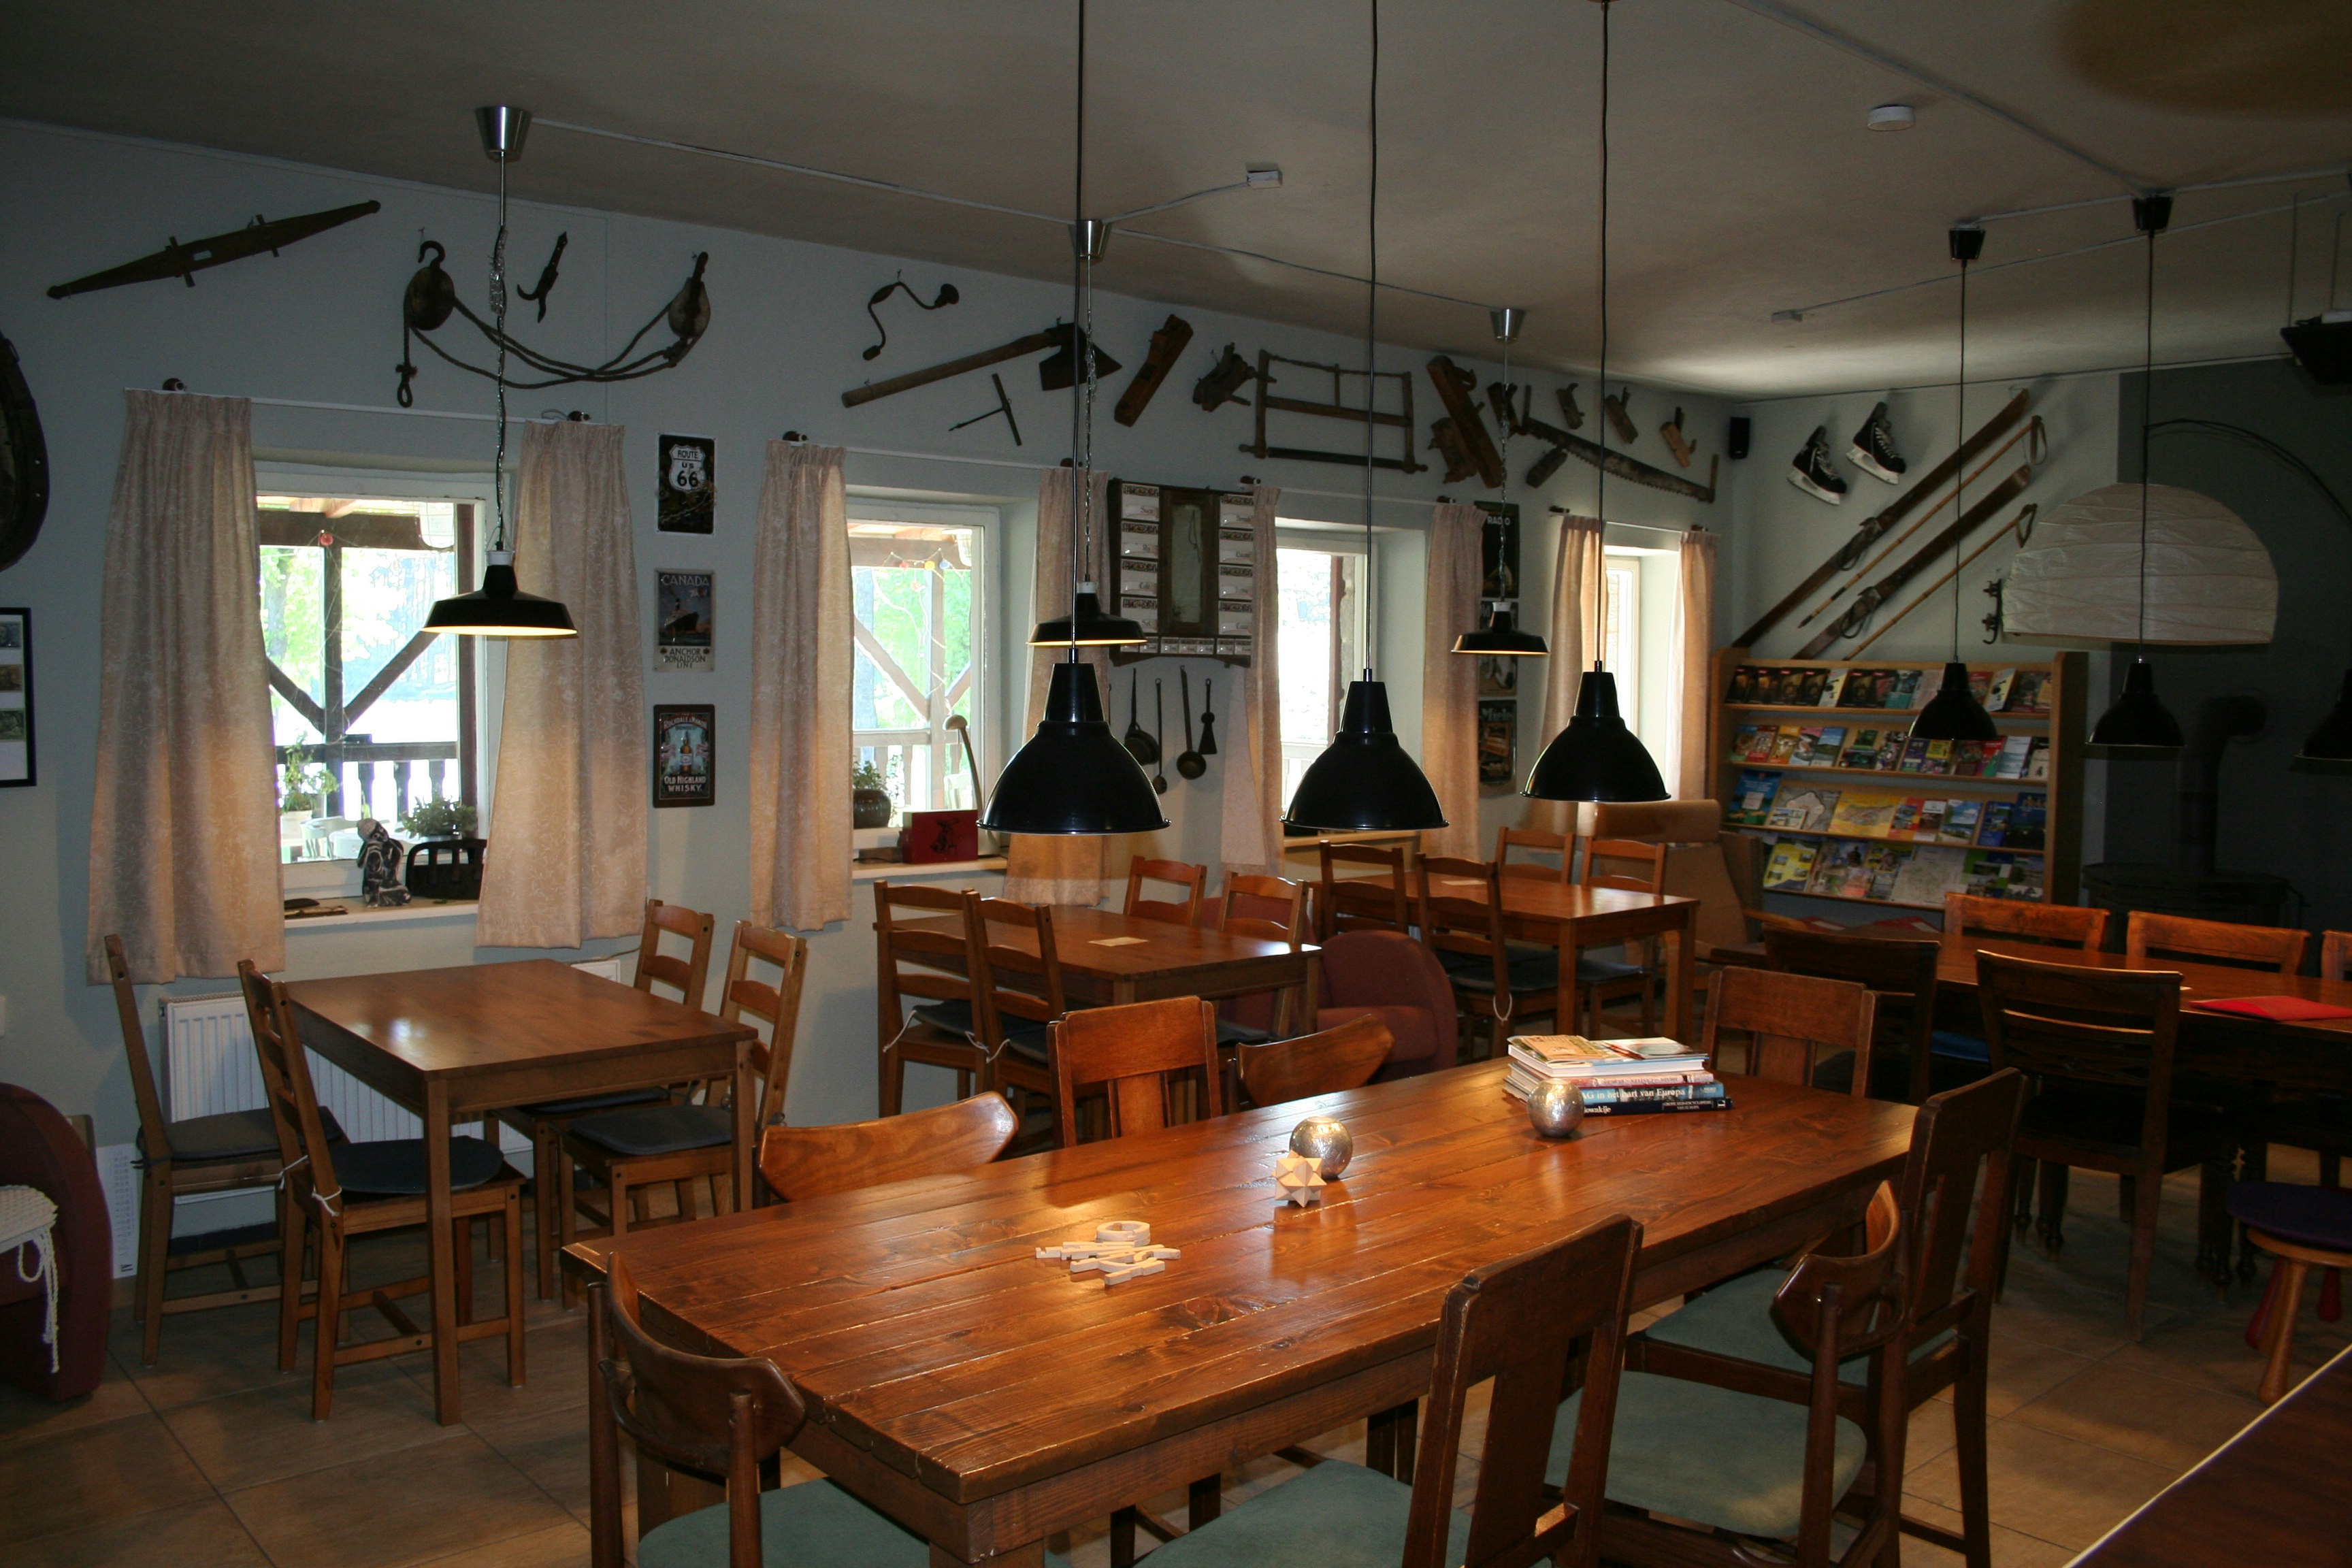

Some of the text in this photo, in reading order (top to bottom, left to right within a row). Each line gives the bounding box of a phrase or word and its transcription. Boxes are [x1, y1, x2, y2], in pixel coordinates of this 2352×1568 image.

[677, 450, 699, 459] ROUTE
[677, 470, 698, 487] 66
[1487, 516, 1511, 526] RADO
[662, 574, 710, 587] CANADA
[670, 647, 701, 655] ANCHOR
[664, 655, 706, 664] DONALDSON
[664, 776, 707, 785] OLD HIGHLAND
[1597, 1091, 1605, 1099] in
[1607, 1090, 1620, 1098] het
[1656, 1088, 1685, 1098] Europa
